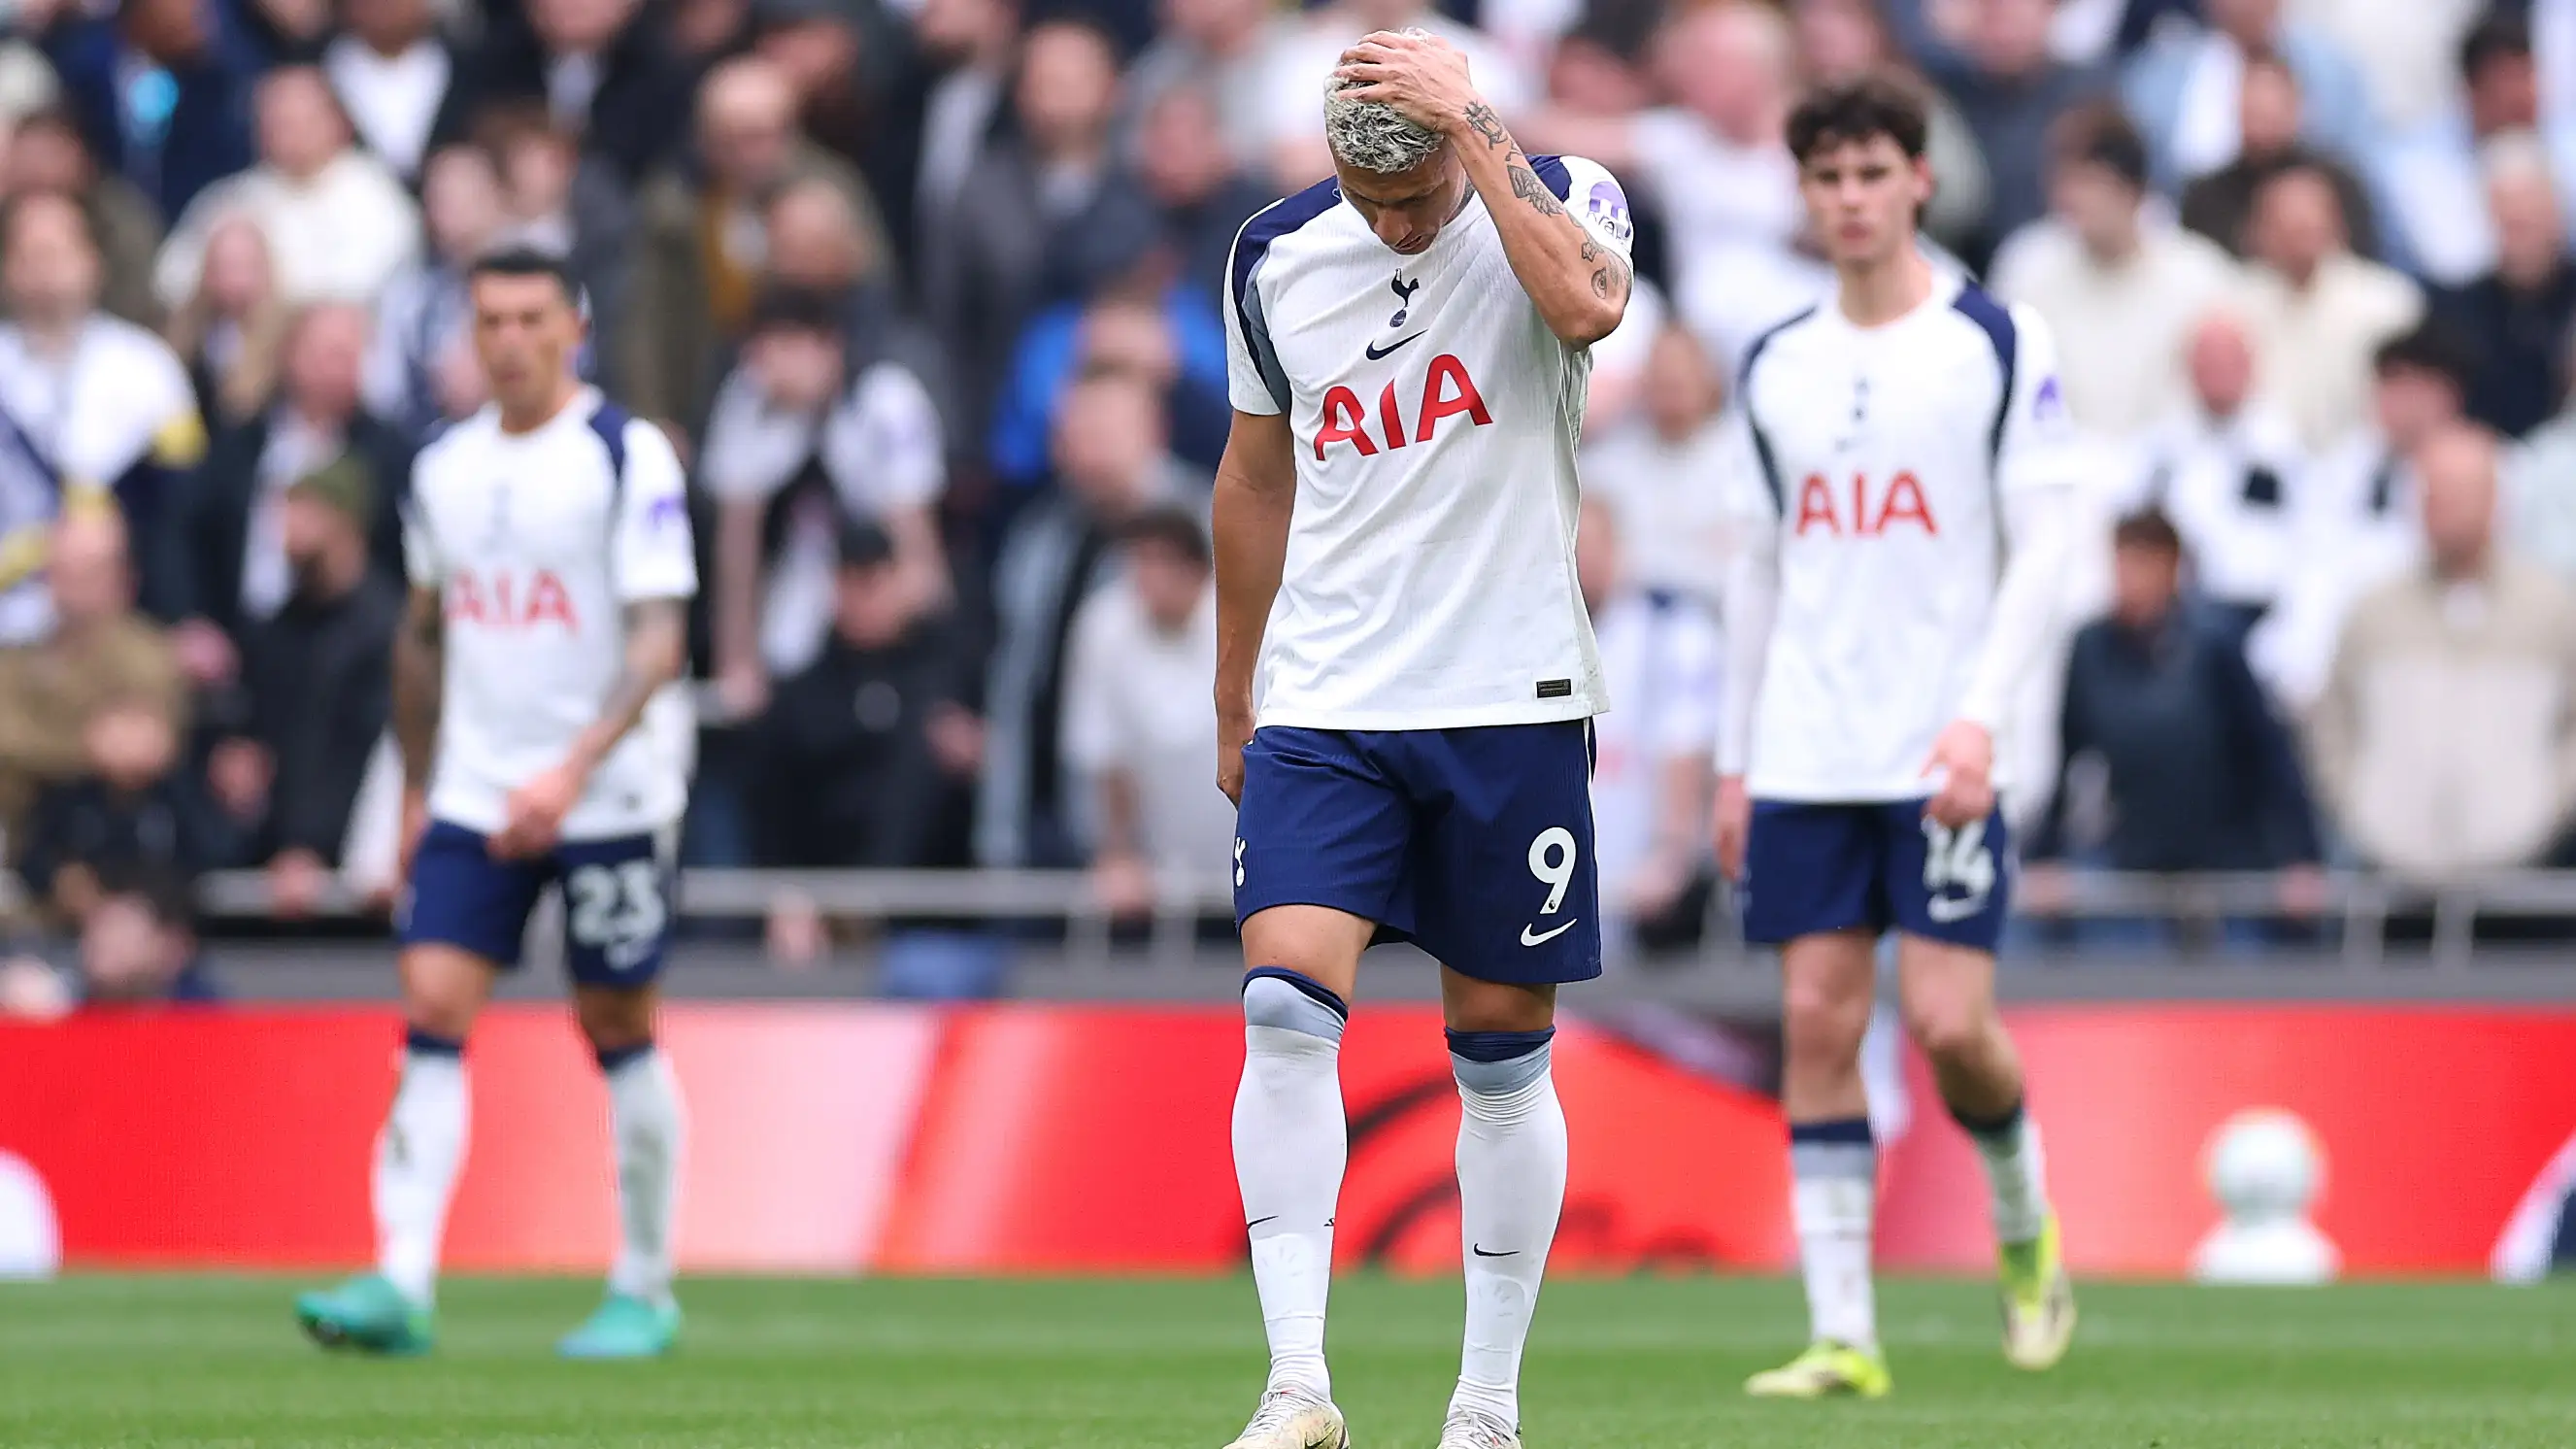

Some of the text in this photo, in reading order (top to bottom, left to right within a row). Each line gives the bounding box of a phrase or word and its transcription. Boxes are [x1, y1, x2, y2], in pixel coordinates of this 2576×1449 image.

[1314, 354, 1493, 461] AIA
[1795, 471, 1940, 536] AIA
[444, 568, 580, 633] AIA
[568, 860, 664, 946] 23
[1528, 826, 1576, 914] 9
